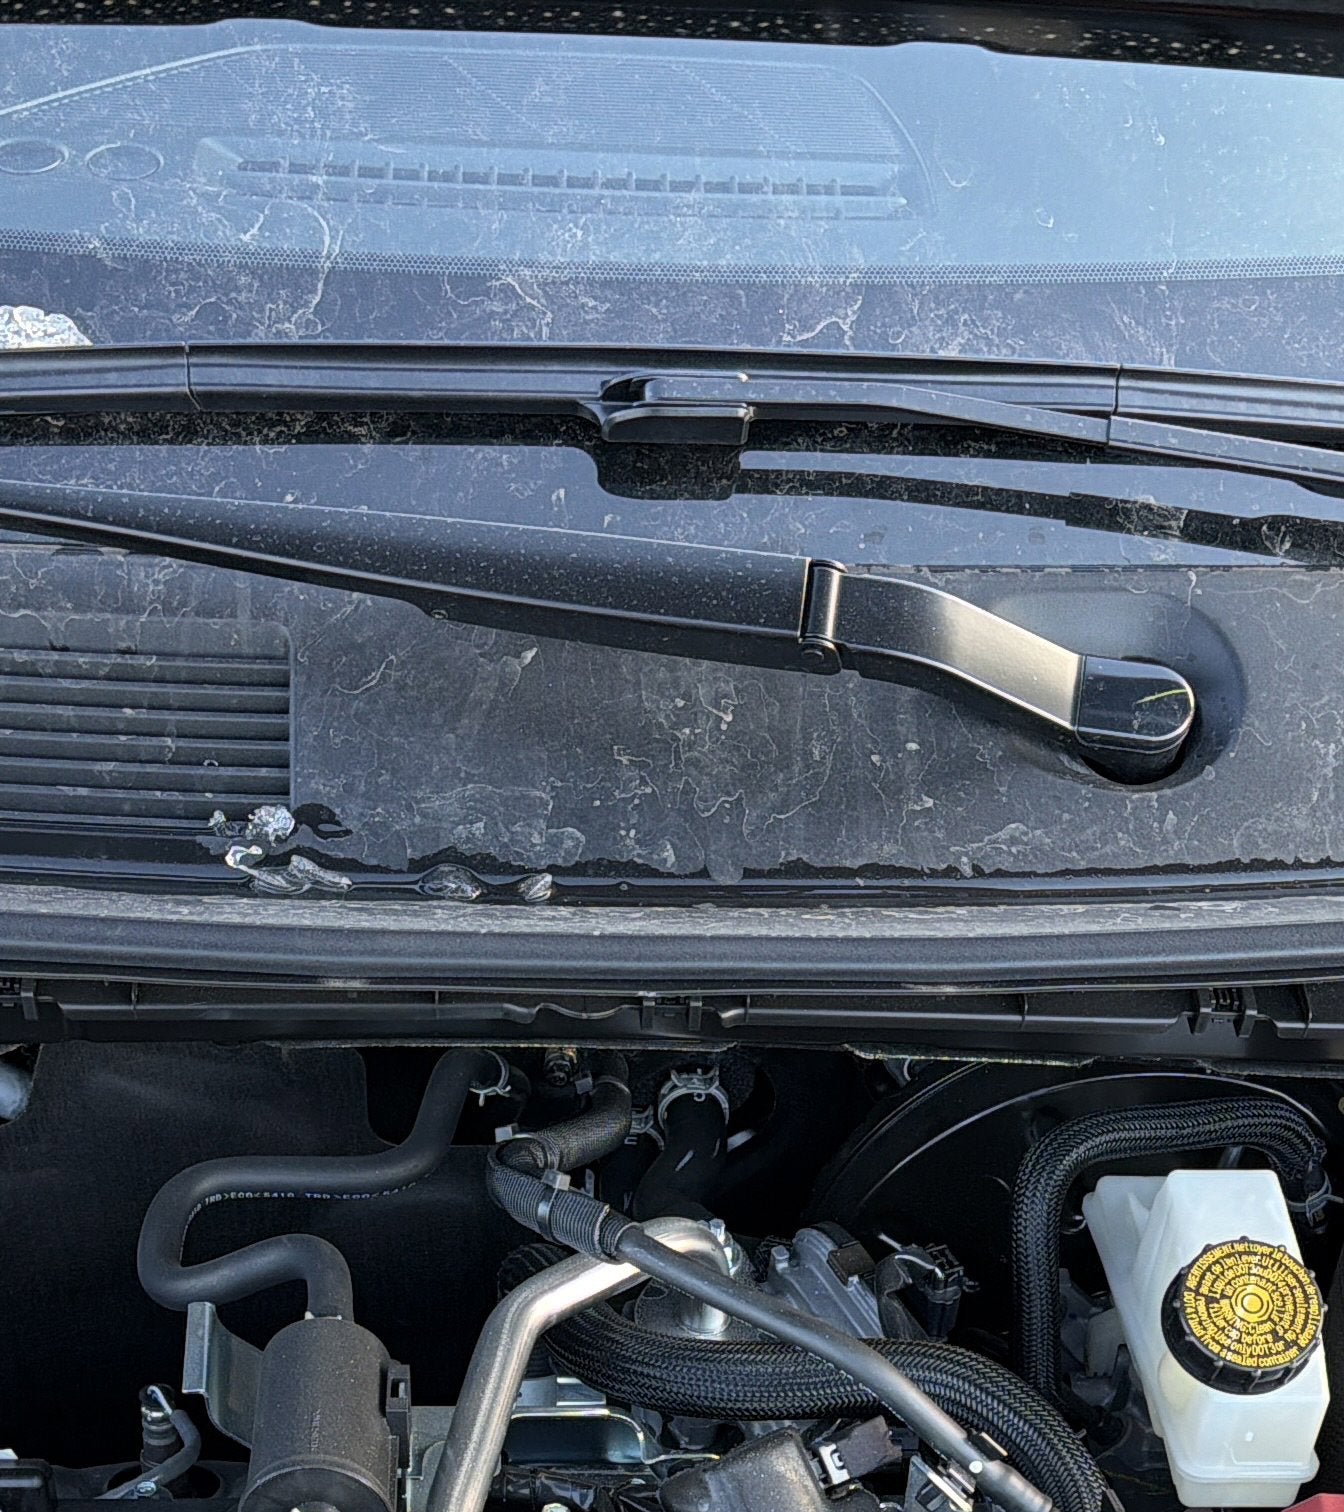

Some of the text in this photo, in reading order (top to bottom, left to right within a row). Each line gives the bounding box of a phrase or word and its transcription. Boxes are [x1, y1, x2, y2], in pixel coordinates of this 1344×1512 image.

[1281, 1255, 1310, 1286] bouchon
[1200, 1333, 1222, 1353] from
[1225, 1352, 1259, 1367] sealed
[1258, 1348, 1300, 1367] container
[1225, 1326, 1241, 1341] cap
[1241, 1333, 1273, 1344] before
